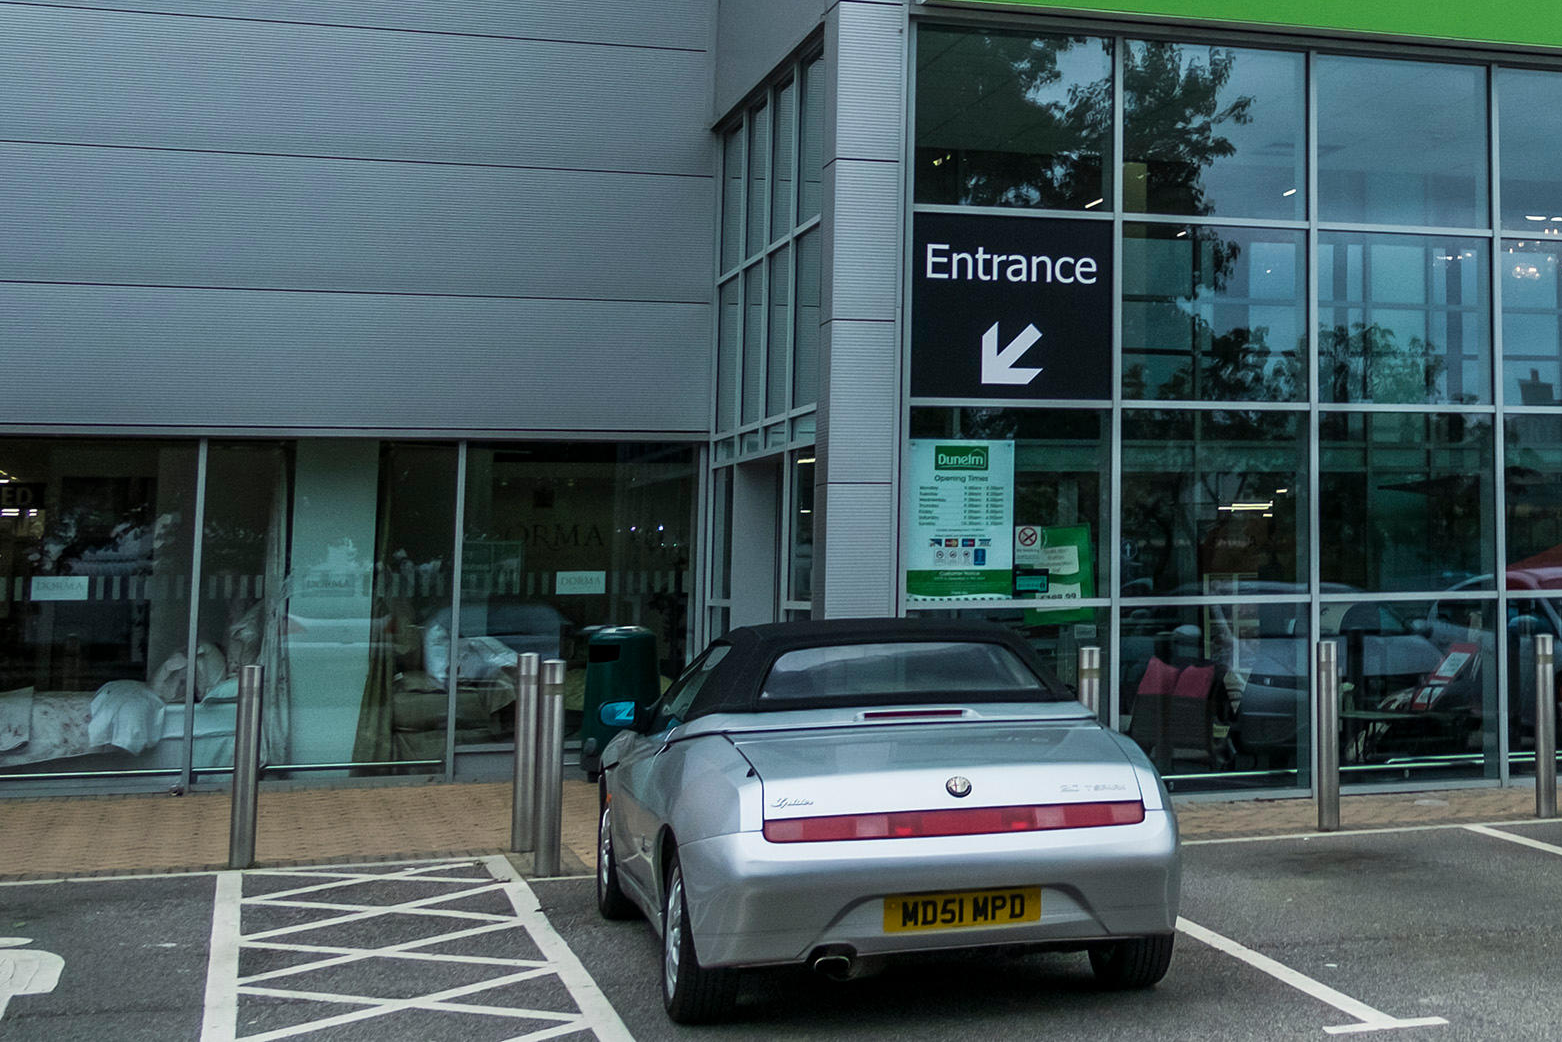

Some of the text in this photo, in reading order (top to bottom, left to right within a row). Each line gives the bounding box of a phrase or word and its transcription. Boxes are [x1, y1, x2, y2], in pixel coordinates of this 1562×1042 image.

[925, 243, 1098, 286] Entrance
[937, 453, 983, 466] Dunelm
[934, 475, 966, 483] Opening
[901, 893, 1025, 926] MD51 MPD
